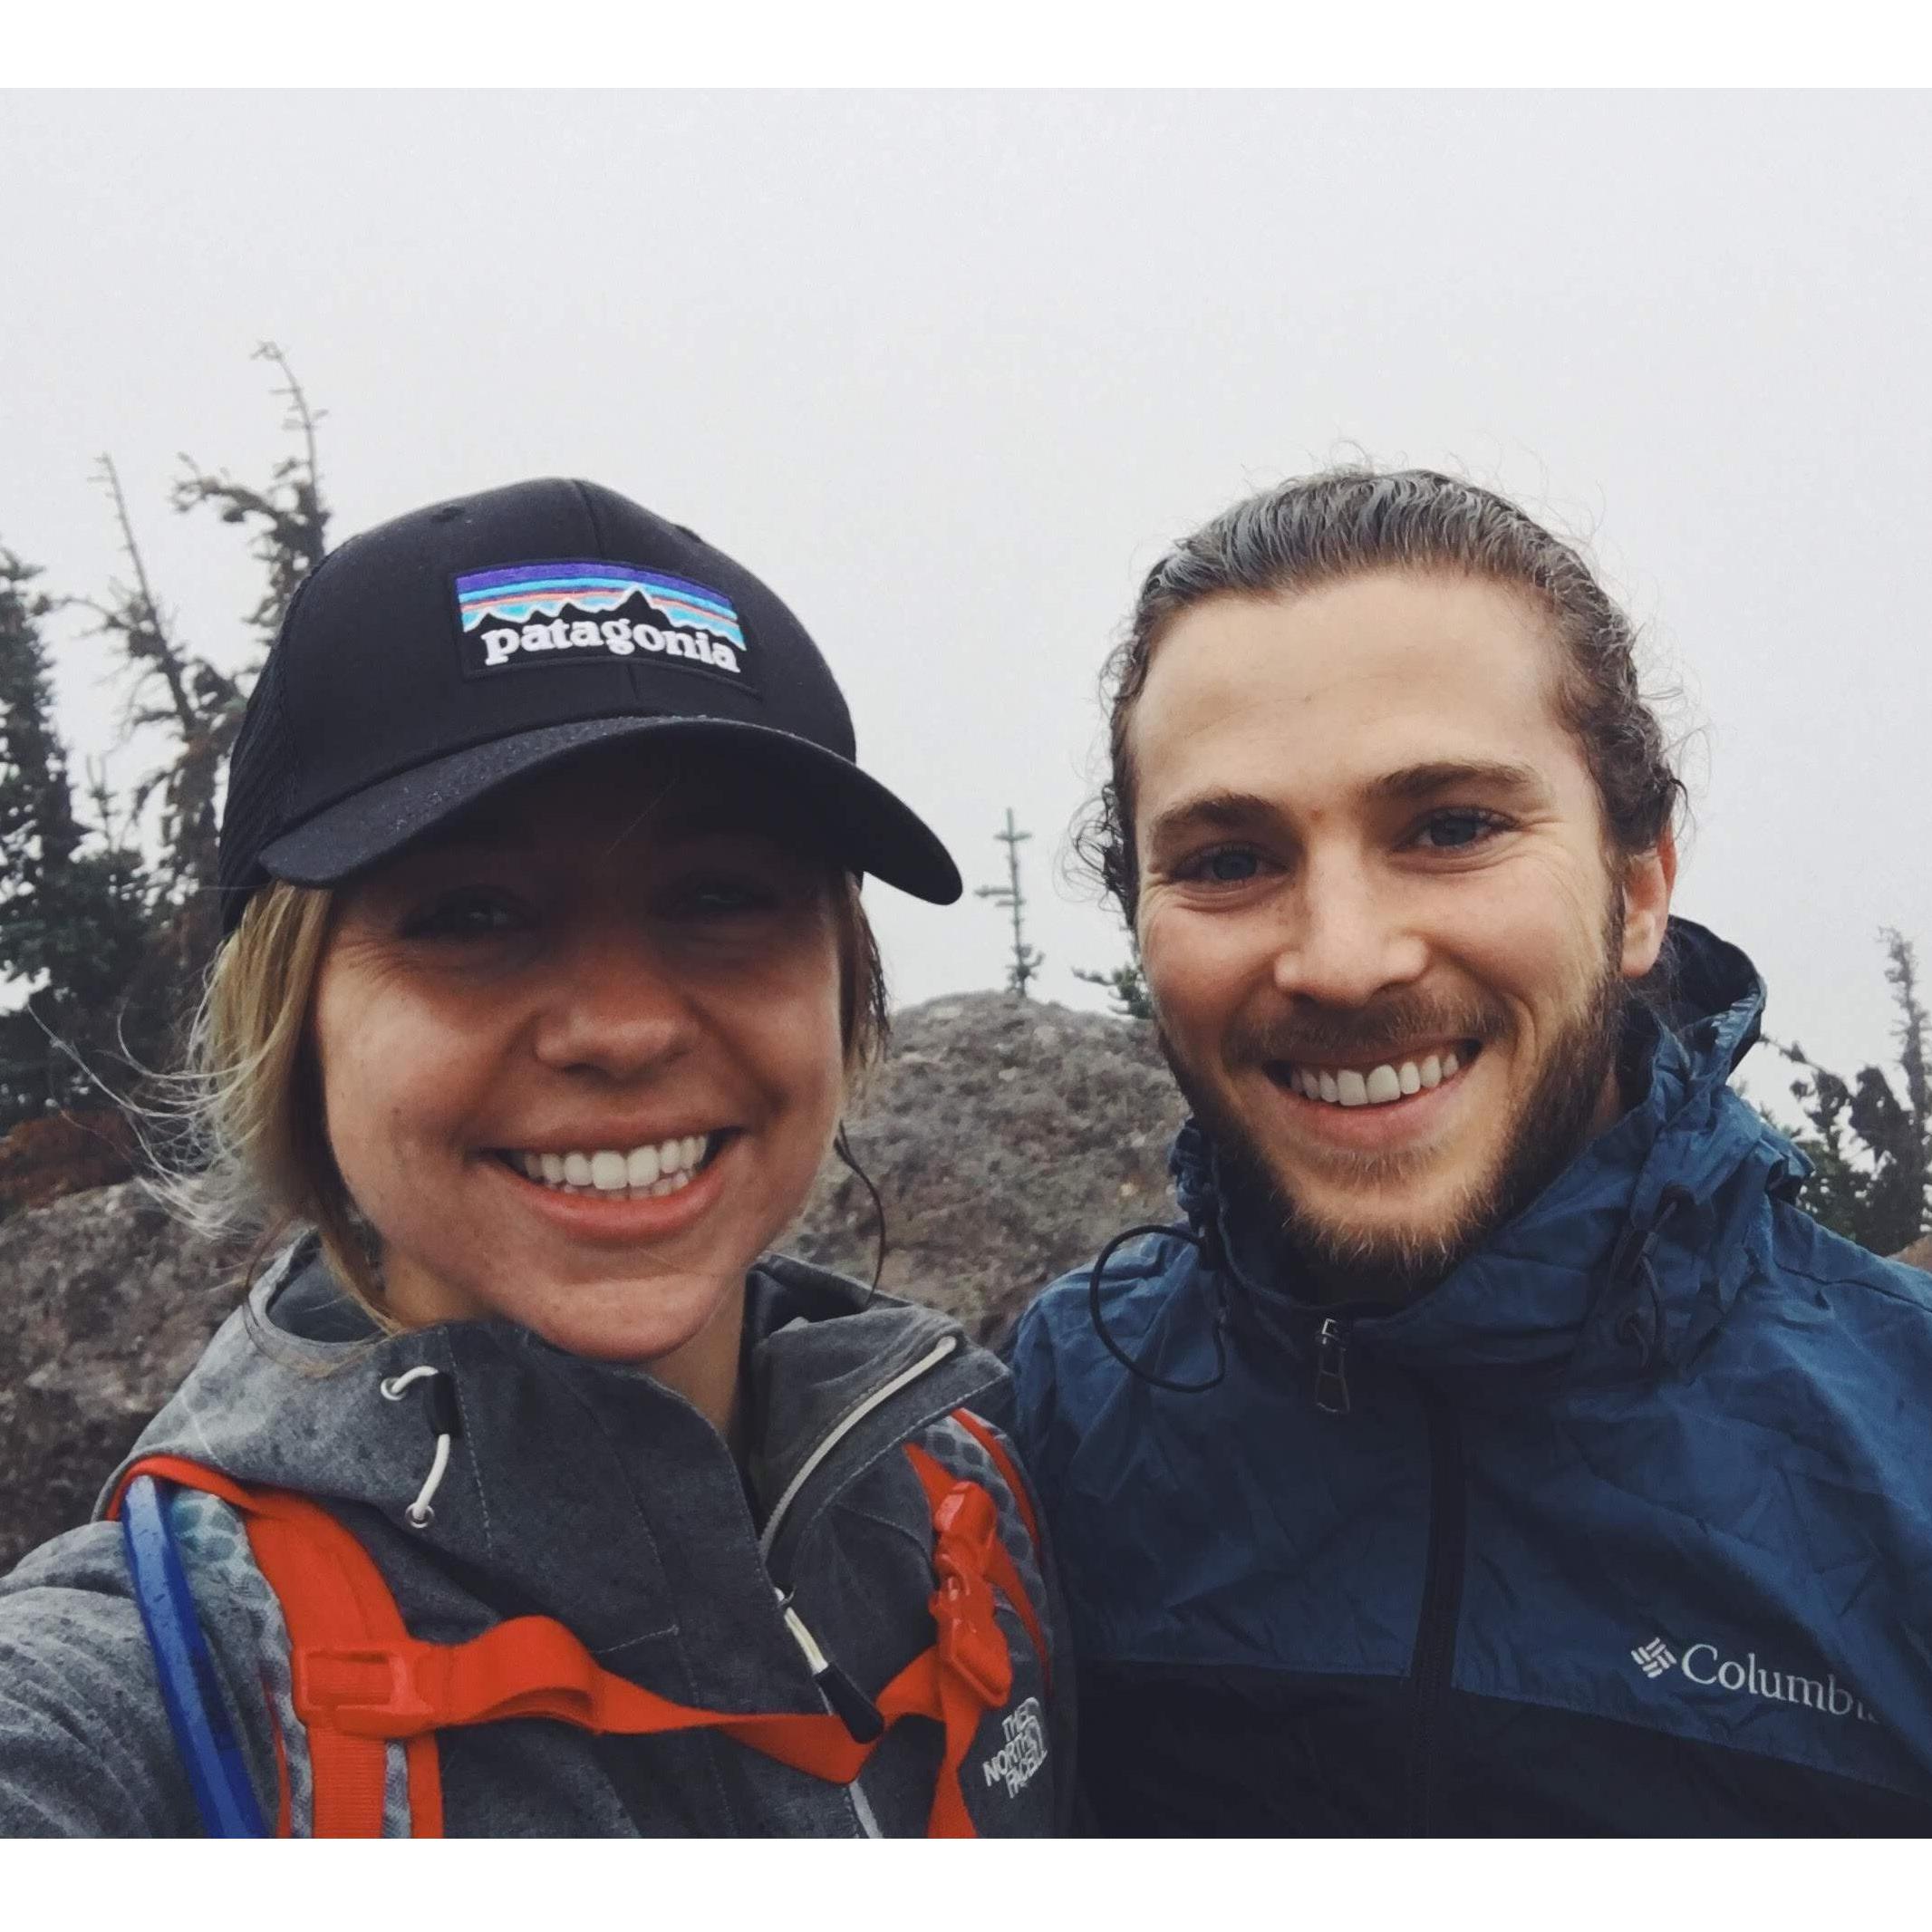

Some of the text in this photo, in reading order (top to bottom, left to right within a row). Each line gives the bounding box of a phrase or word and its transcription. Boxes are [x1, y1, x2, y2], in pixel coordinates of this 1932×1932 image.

[480, 618, 741, 673] patagonia
[1001, 1705, 1029, 1742] THE
[982, 1732, 1030, 1787] NORTH
[1006, 1749, 1036, 1799] FACE
